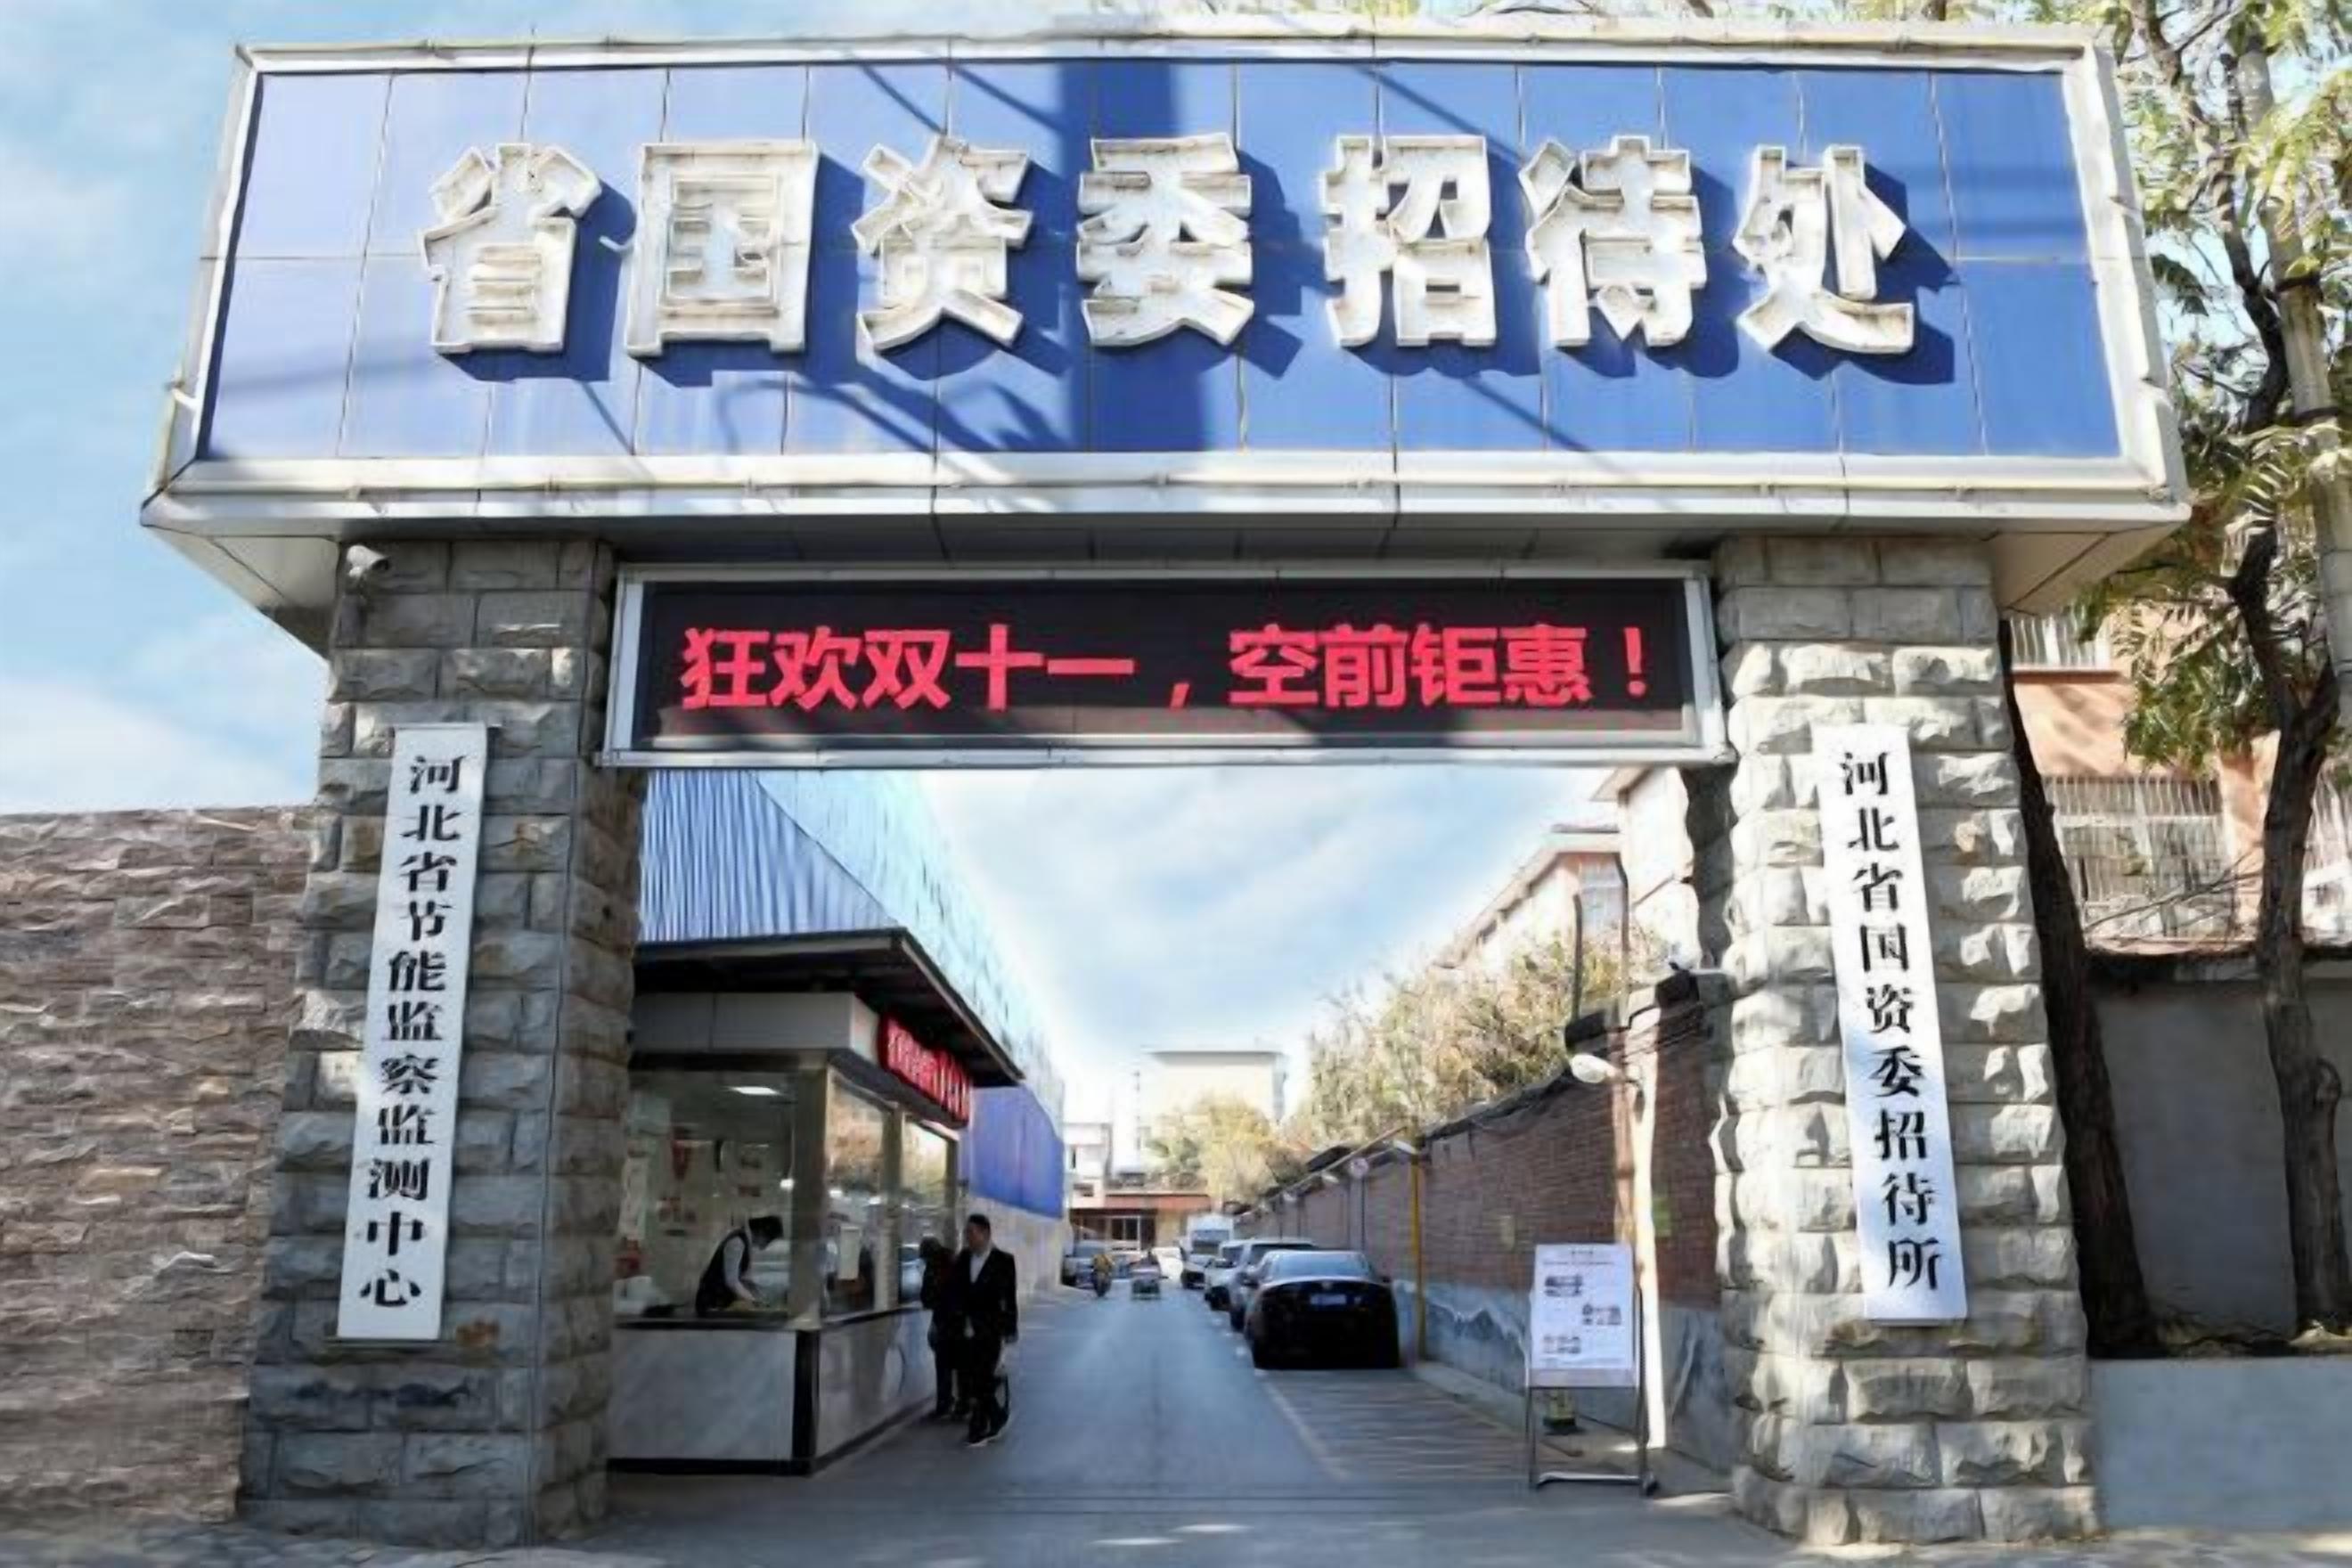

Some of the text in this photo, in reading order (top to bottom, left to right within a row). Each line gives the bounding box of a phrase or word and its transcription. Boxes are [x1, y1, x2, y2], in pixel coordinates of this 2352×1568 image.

[419, 134, 1915, 355] 省国资委招待处
[359, 755, 464, 1308] 河北省节能监察监测中心
[1840, 751, 1940, 1290] 河北省国资委招待所
